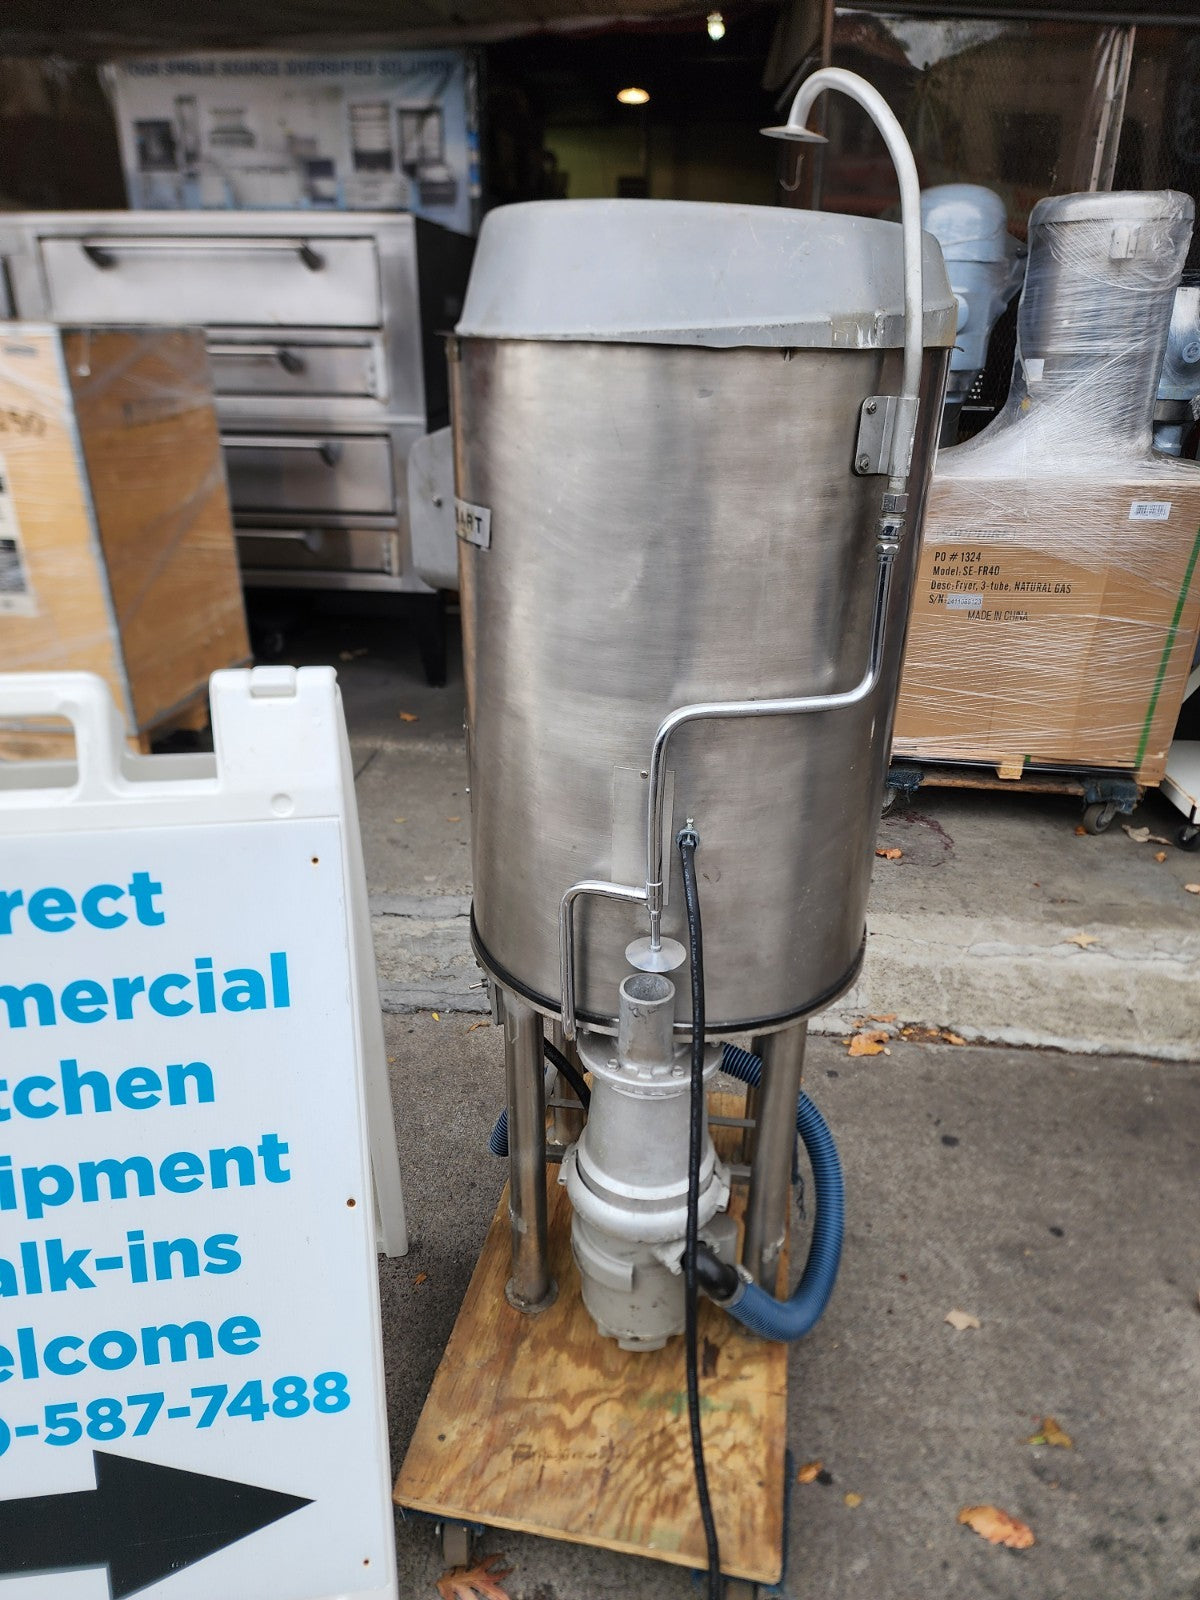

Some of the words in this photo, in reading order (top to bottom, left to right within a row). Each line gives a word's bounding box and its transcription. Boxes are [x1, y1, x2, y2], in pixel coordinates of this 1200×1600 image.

[932, 566, 961, 576] Model:
[962, 566, 1000, 576] SE-FR40
[934, 552, 947, 562] PO
[949, 553, 959, 562] #
[961, 552, 982, 562] 1324
[930, 580, 954, 590] Desc:
[980, 581, 1011, 592] 3-tube,
[1014, 582, 1052, 593] NATURAL
[1054, 583, 1072, 594] GAS
[967, 610, 992, 621] MADE
[994, 611, 1003, 621] IN
[1004, 611, 1029, 621] CHINA
[0, 872, 165, 935] rect
[0, 952, 291, 1029] mercial
[0, 1059, 216, 1123] chen
[0, 1134, 291, 1220] ipment
